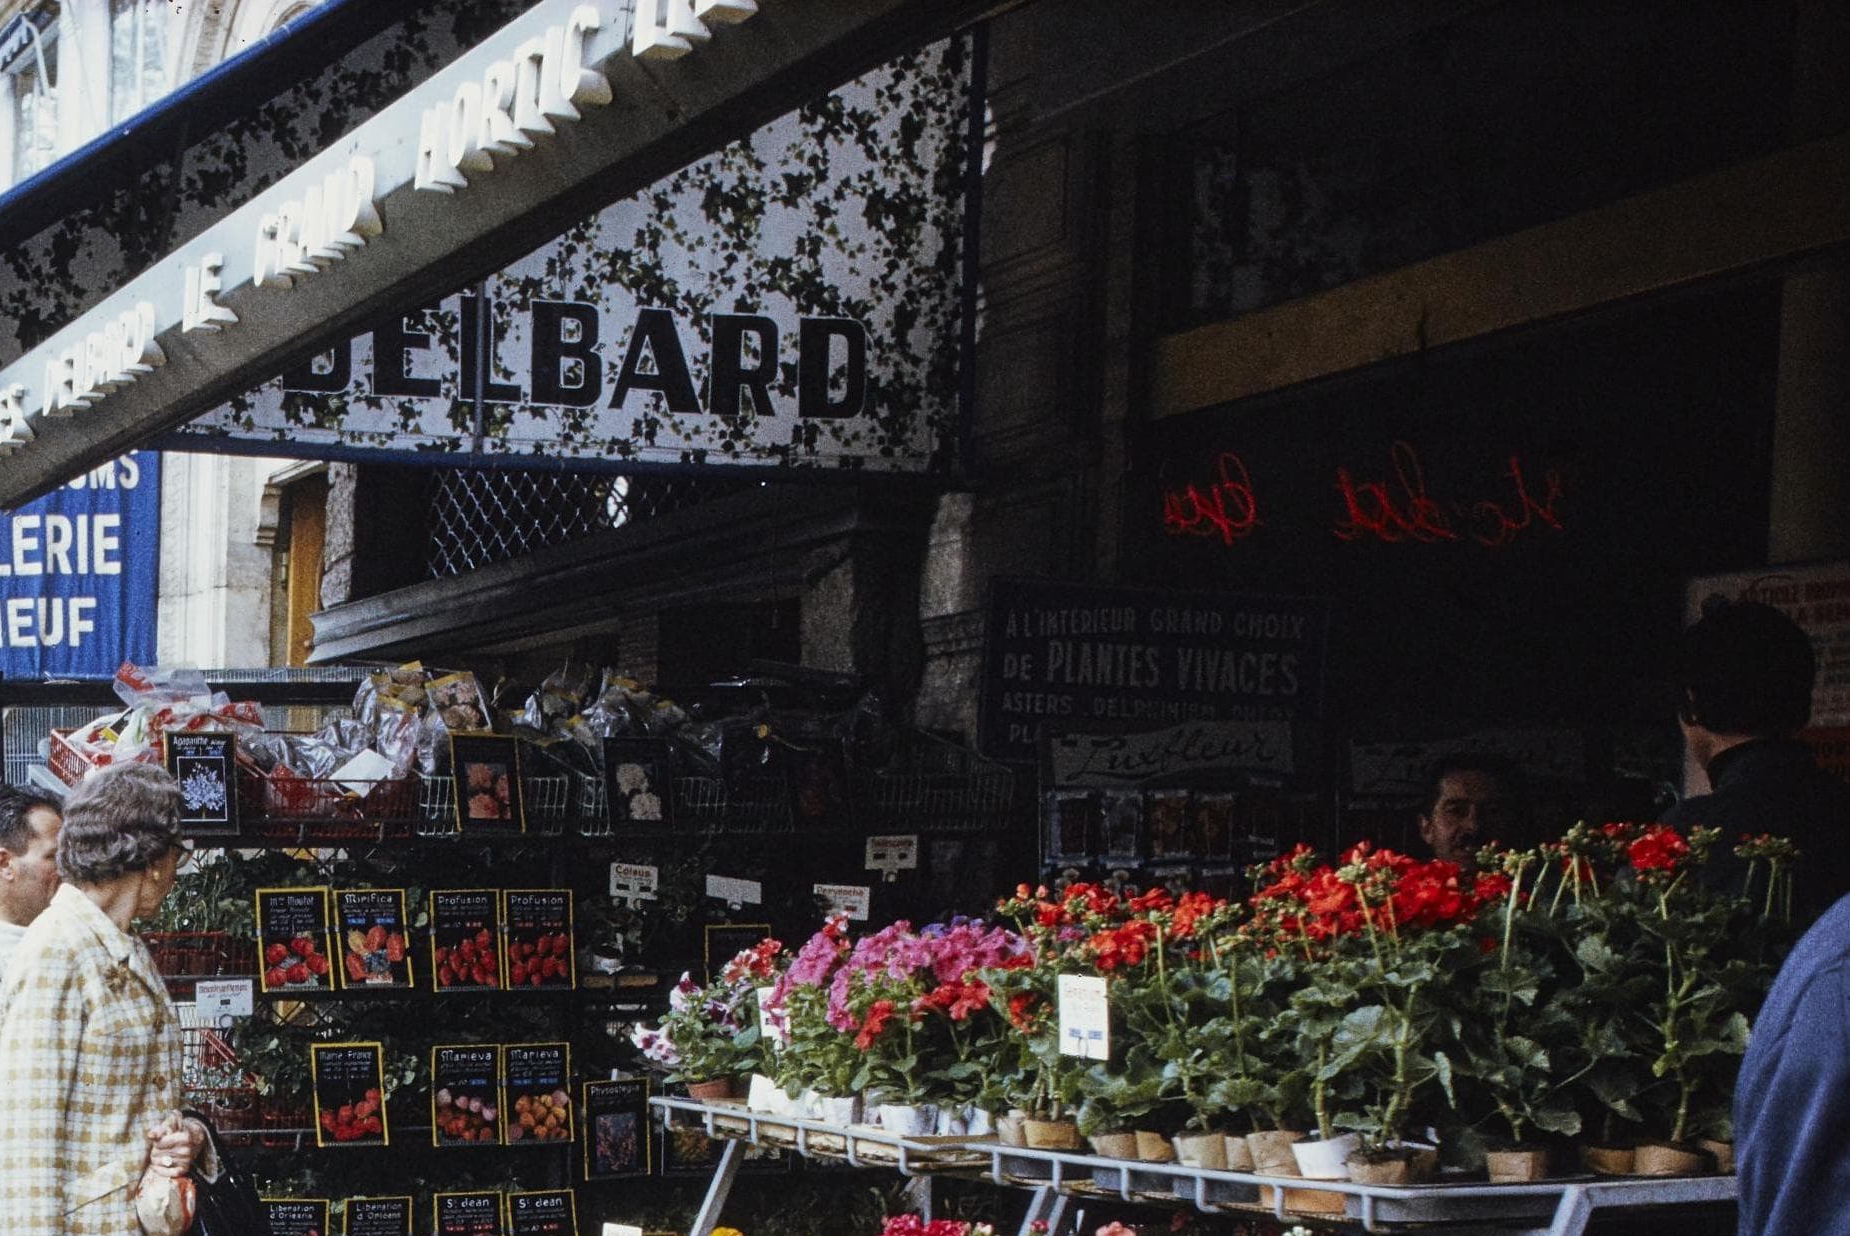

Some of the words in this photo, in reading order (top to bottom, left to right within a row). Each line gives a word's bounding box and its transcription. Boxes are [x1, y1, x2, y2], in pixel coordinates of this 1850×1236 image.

[182, 252, 238, 333] LE
[1150, 607, 1223, 635] GRAND
[1233, 610, 1303, 639] CHOIX
[1003, 652, 1033, 681] DE
[1046, 640, 1160, 689] PLANTES
[1176, 648, 1300, 696] VIVACES
[1001, 692, 1074, 715] ASTERS
[438, 895, 488, 905] Profusion
[510, 895, 564, 905] Profusion
